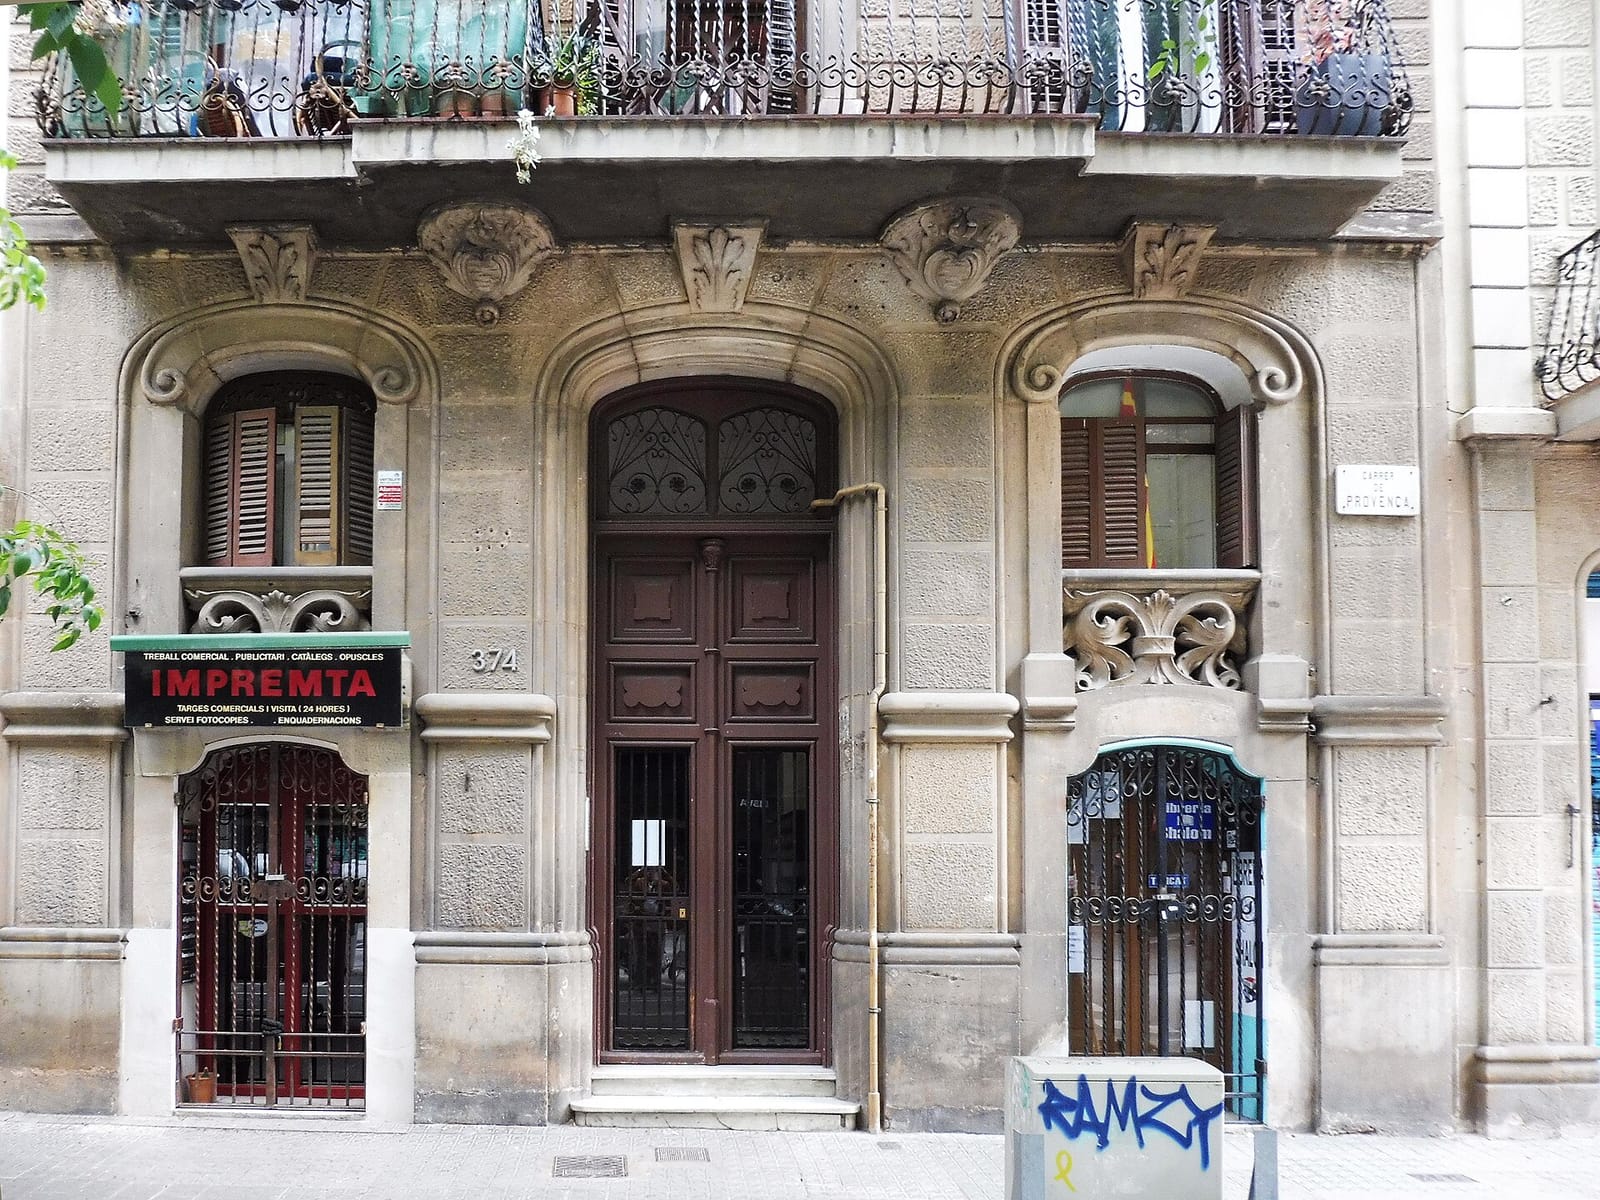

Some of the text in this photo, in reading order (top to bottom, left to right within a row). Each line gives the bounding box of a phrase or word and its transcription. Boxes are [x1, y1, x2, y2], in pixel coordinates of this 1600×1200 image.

[143, 652, 180, 661] TREBALL
[180, 652, 229, 661] COMERCIAL
[235, 652, 285, 661] PUBLICITARI
[339, 652, 384, 661] OPUSCLES
[471, 649, 519, 673] 374
[152, 669, 377, 698] IMPREMTA
[177, 704, 210, 713] TARGES
[210, 704, 265, 713] COMERCIALS
[271, 704, 297, 713] VISITA
[164, 716, 362, 725] SERVEI FOTOCOPIES ENQUADERNACIONS
